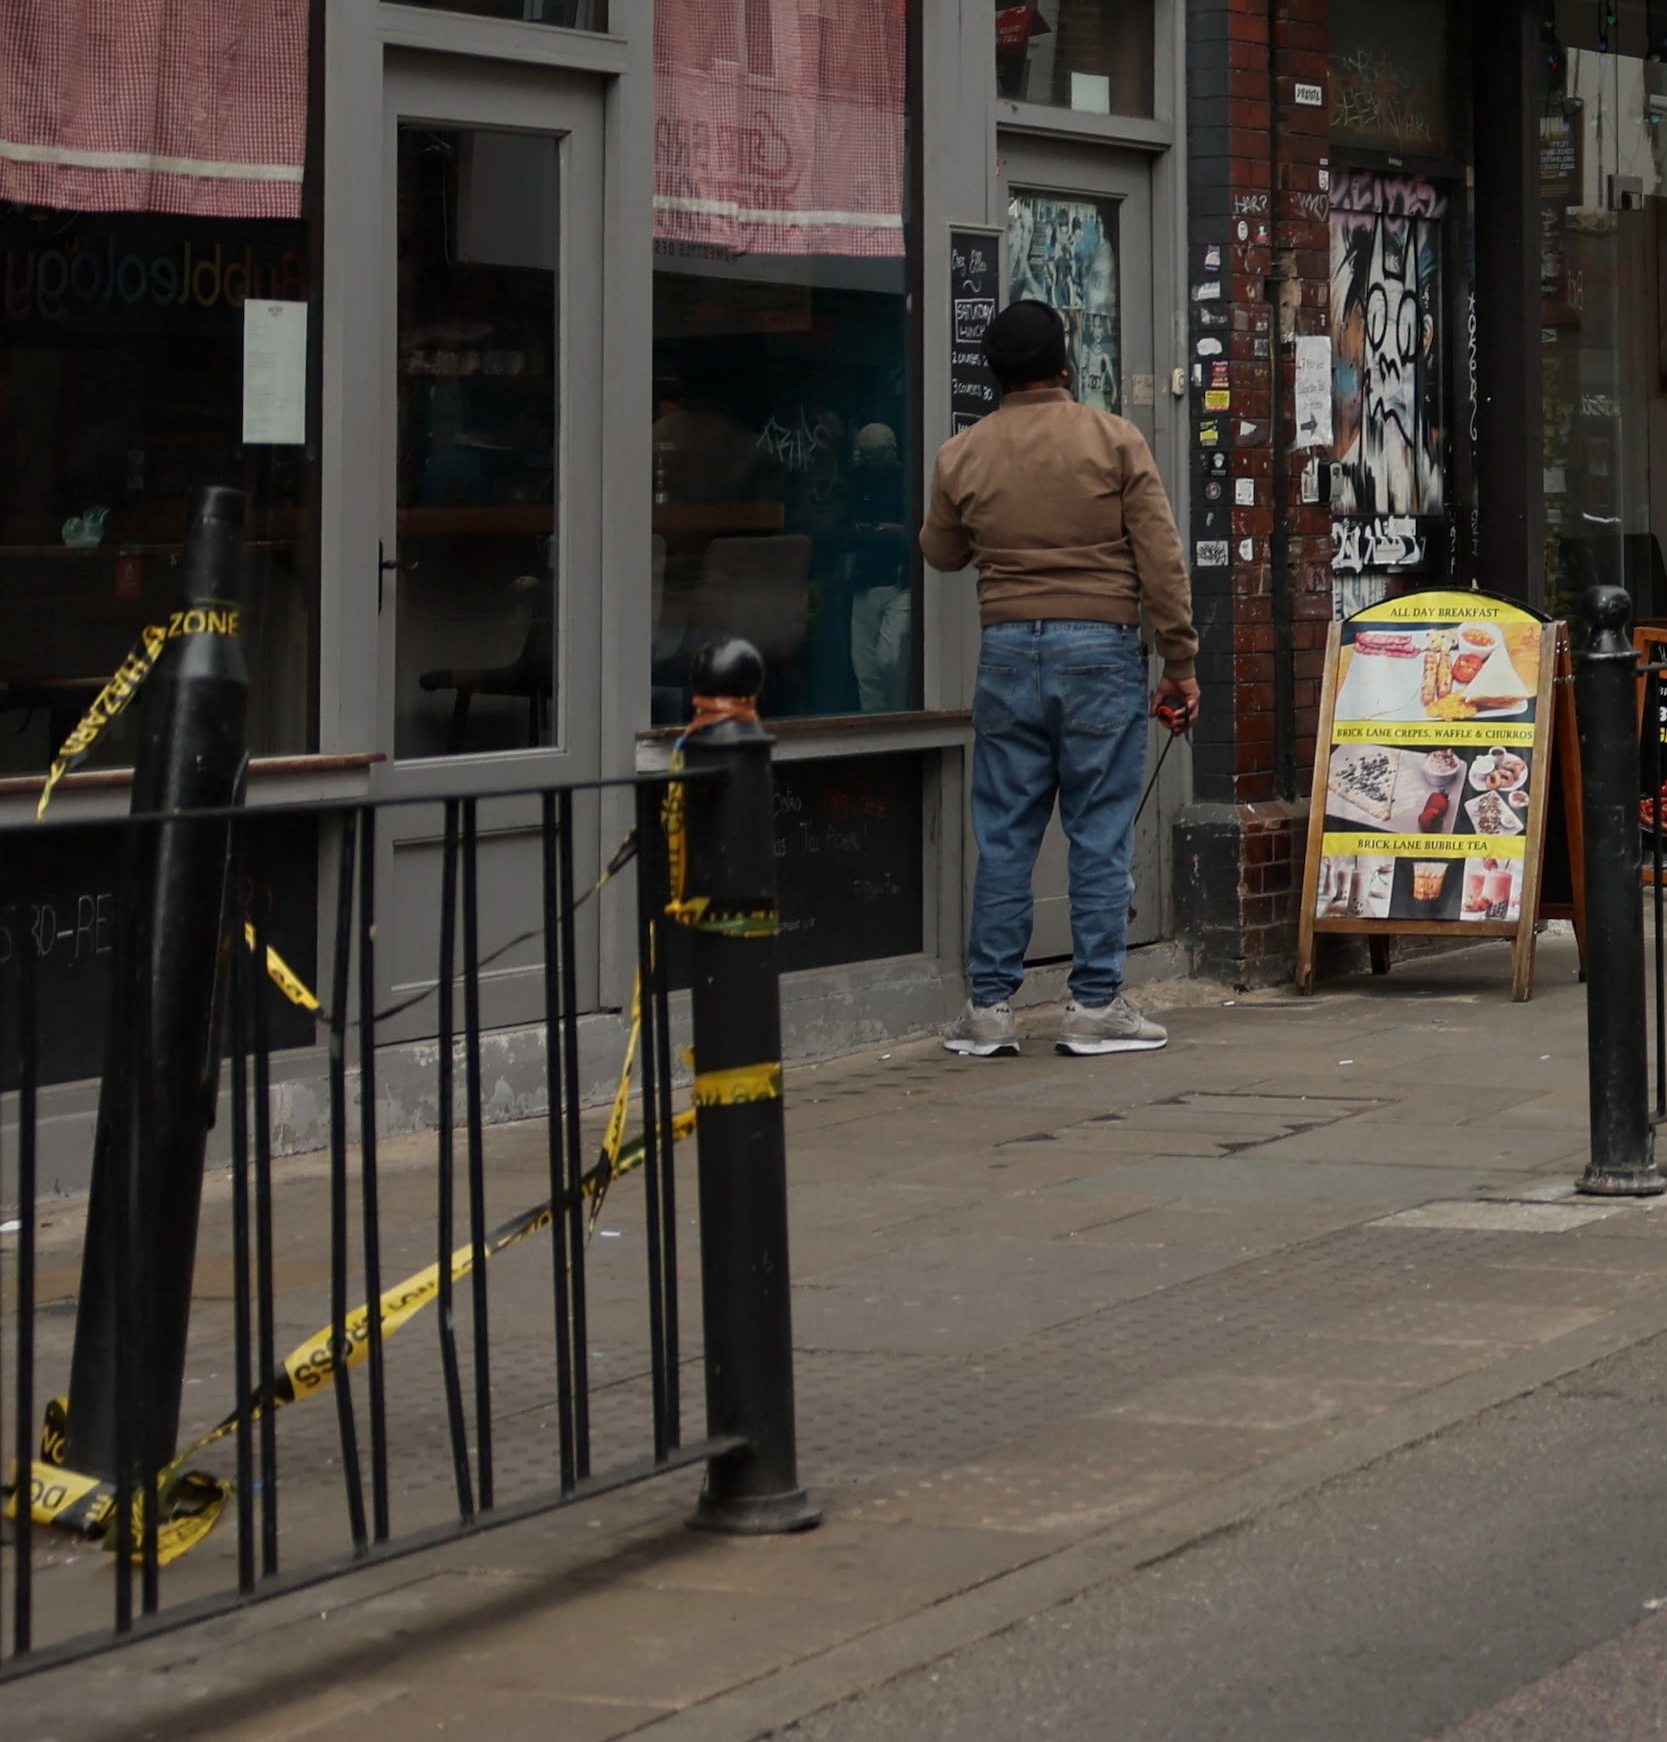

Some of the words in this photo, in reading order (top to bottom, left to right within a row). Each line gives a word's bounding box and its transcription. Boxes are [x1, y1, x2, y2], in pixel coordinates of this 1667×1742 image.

[1390, 608, 1410, 617] ALL
[1412, 608, 1435, 617] DAY
[1438, 608, 1500, 618] BREAKFAST
[168, 610, 241, 638] ZONE
[1337, 729, 1364, 738] BRICK
[1366, 729, 1392, 738] LANE
[1394, 729, 1432, 739] CREPES,
[1435, 730, 1473, 739] WAFFLE
[1474, 730, 1482, 739] &
[1485, 730, 1533, 739] CHURROS
[1357, 839, 1391, 849] BRICK
[1393, 839, 1422, 850] LANE
[1424, 840, 1464, 851] BUBBLE
[1466, 841, 1488, 851] TEA
